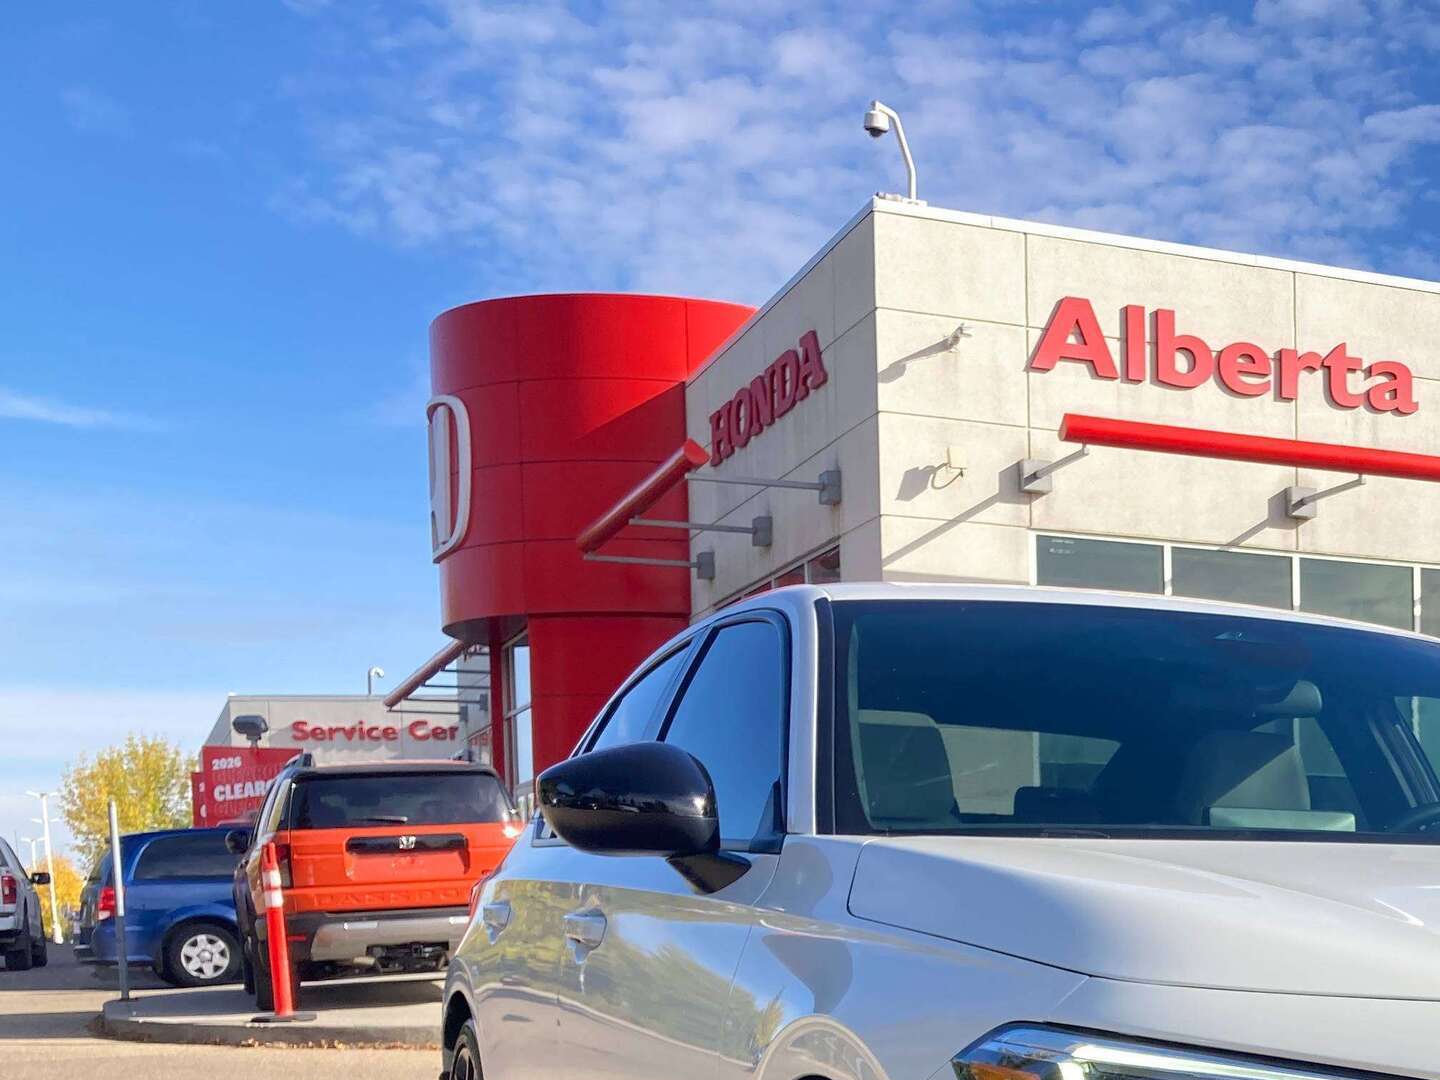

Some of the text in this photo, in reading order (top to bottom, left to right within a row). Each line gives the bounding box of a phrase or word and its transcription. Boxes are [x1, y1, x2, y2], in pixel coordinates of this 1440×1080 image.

[1031, 296, 1419, 416] Alberta
[708, 329, 829, 468] HONDA
[211, 756, 242, 771] 2026
[291, 720, 398, 742] Service
